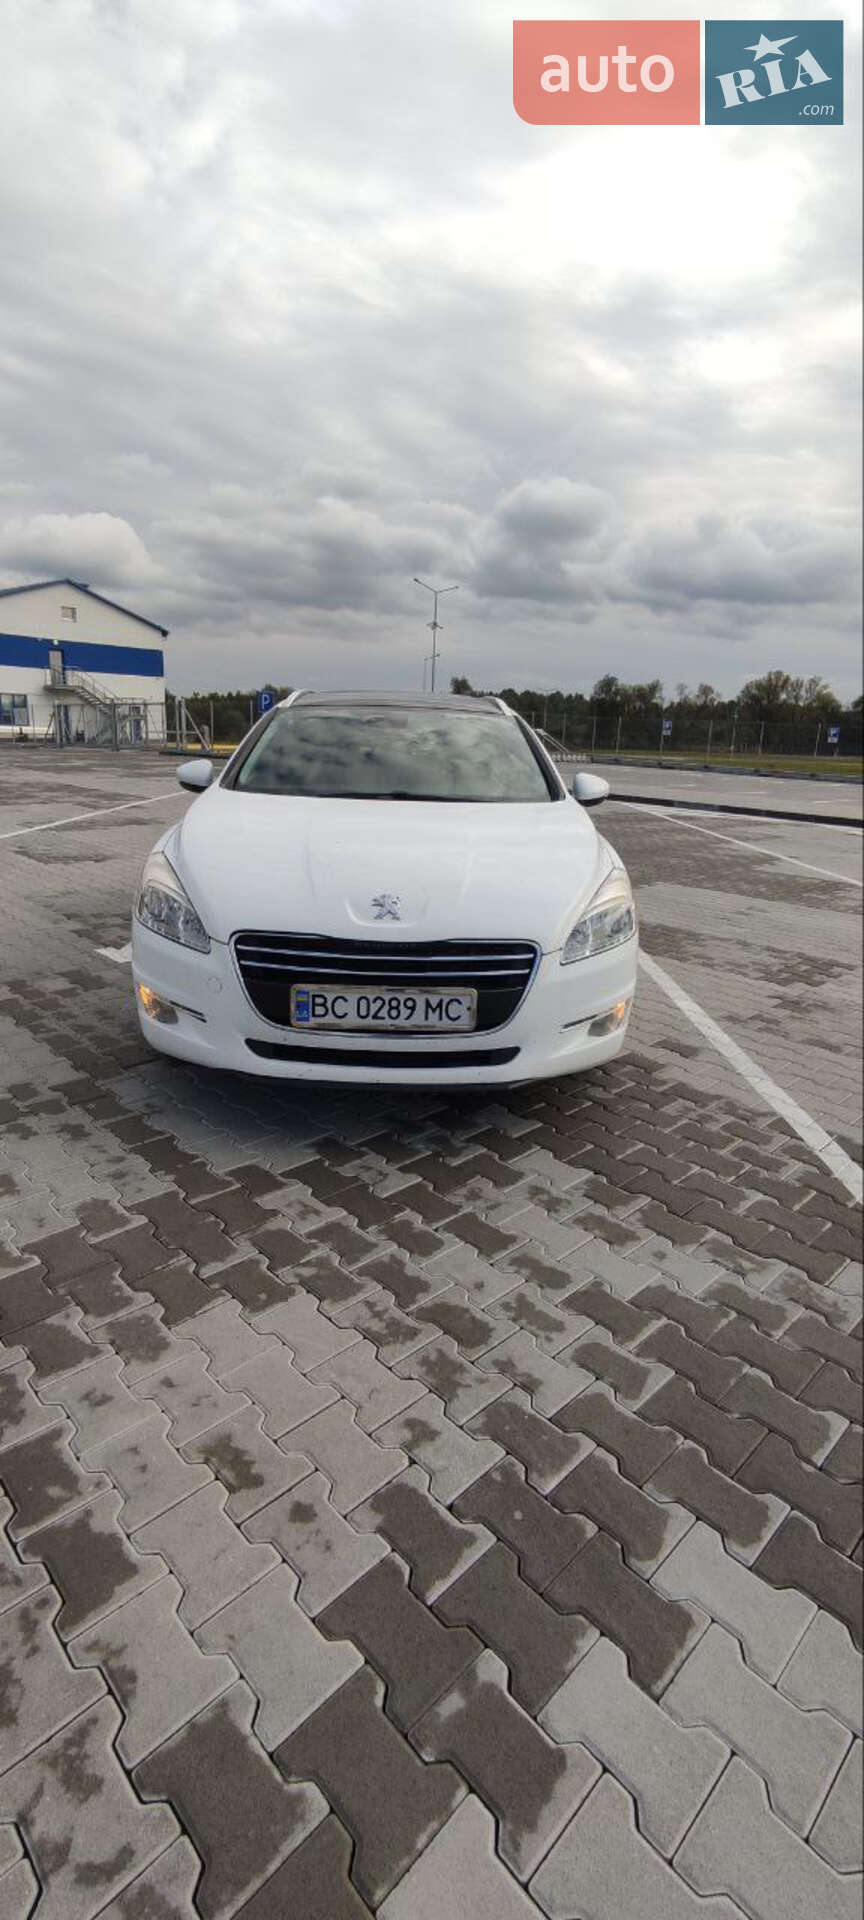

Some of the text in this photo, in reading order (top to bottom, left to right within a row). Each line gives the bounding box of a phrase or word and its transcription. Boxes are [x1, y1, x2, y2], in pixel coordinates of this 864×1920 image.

[311, 994, 463, 1022] BC 0289 MC
